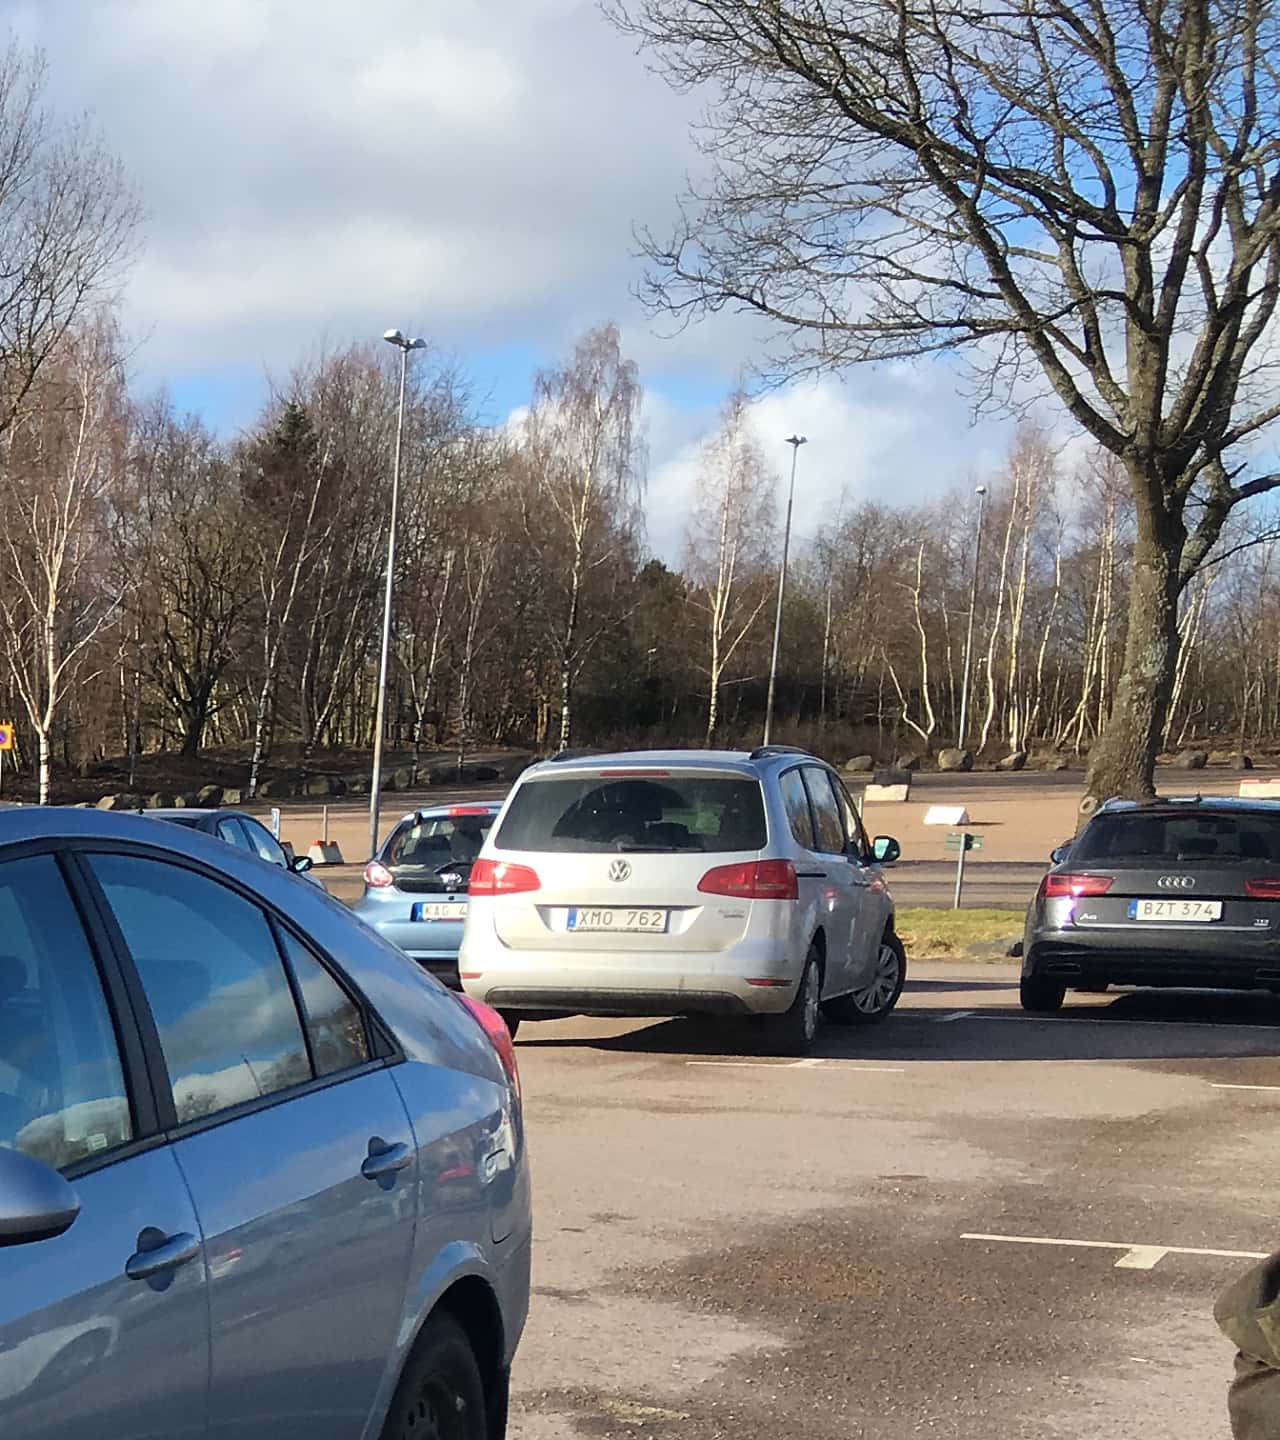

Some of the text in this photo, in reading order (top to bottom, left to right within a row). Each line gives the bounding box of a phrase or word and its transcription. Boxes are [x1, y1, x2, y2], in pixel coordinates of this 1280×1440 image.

[1143, 902, 1214, 916] BZT 374
[579, 911, 663, 927] XMO 762
